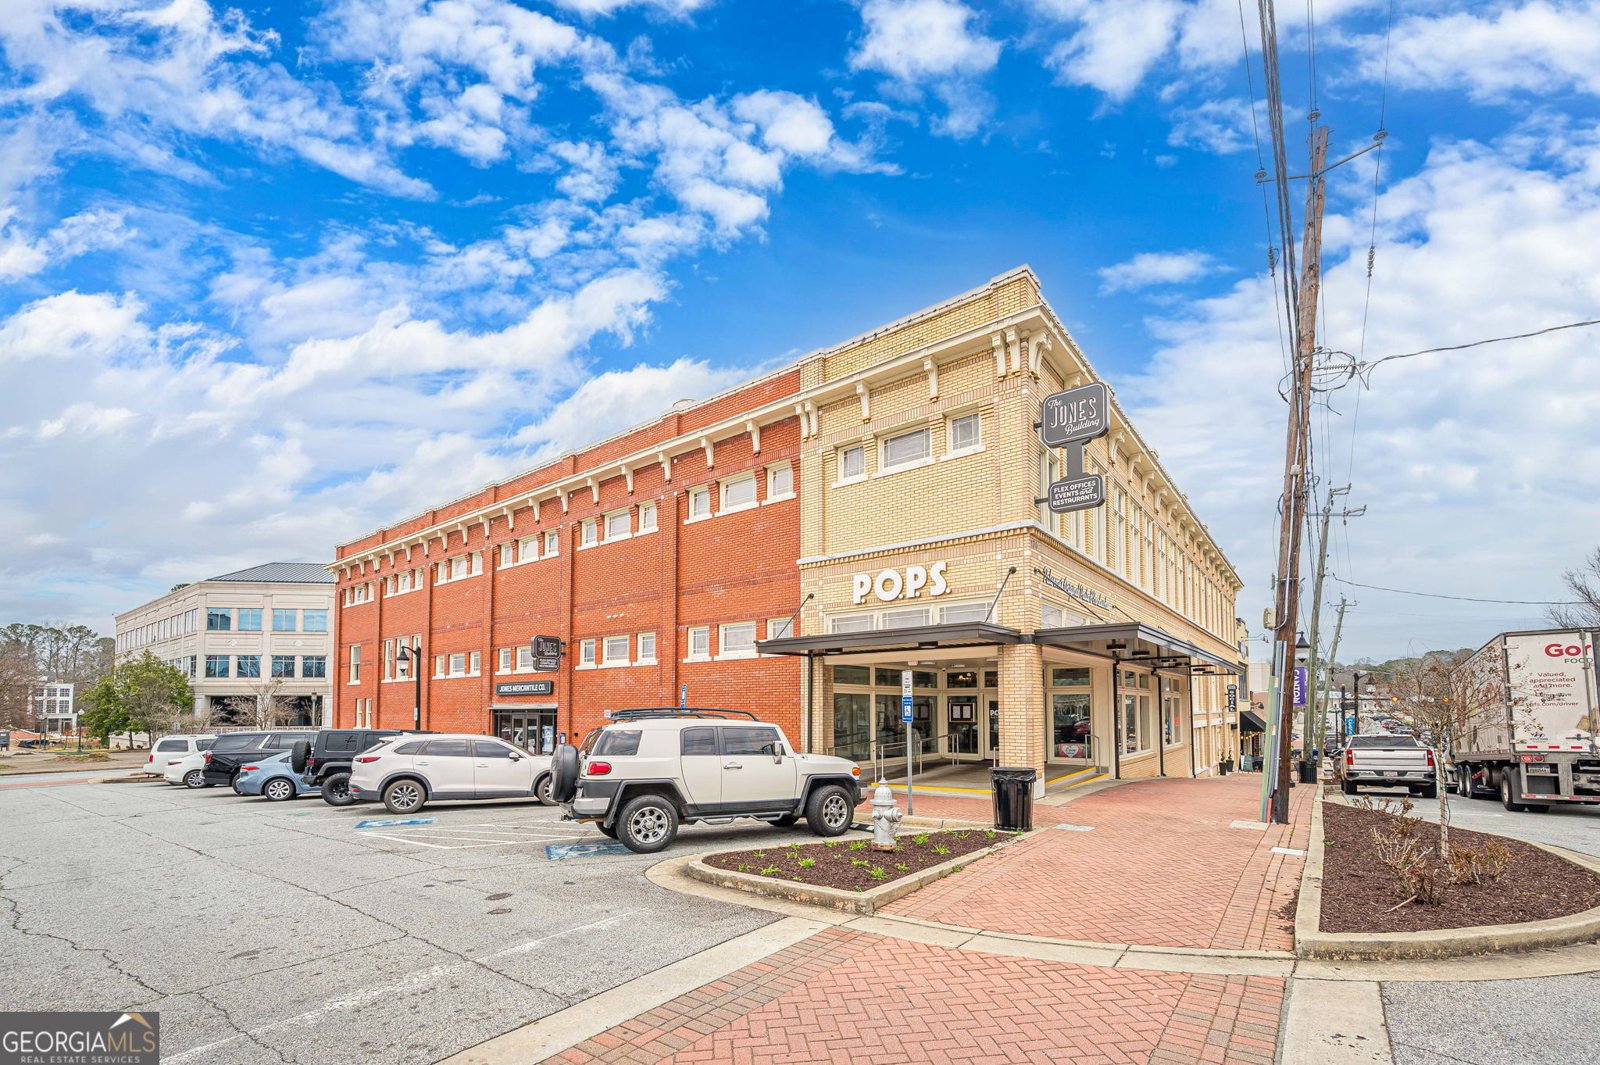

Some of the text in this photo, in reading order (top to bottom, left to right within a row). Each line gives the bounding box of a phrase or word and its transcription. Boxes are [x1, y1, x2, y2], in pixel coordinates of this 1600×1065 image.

[1048, 399, 1062, 409] The
[1050, 397, 1096, 428] JONES
[1065, 418, 1100, 435] Building
[1069, 480, 1096, 490] OFFICES
[1055, 487, 1093, 500] EVENTS and
[499, 685, 512, 693] JONES
[512, 684, 538, 692] MERCANTILE
[1293, 669, 1301, 704] CANTON
